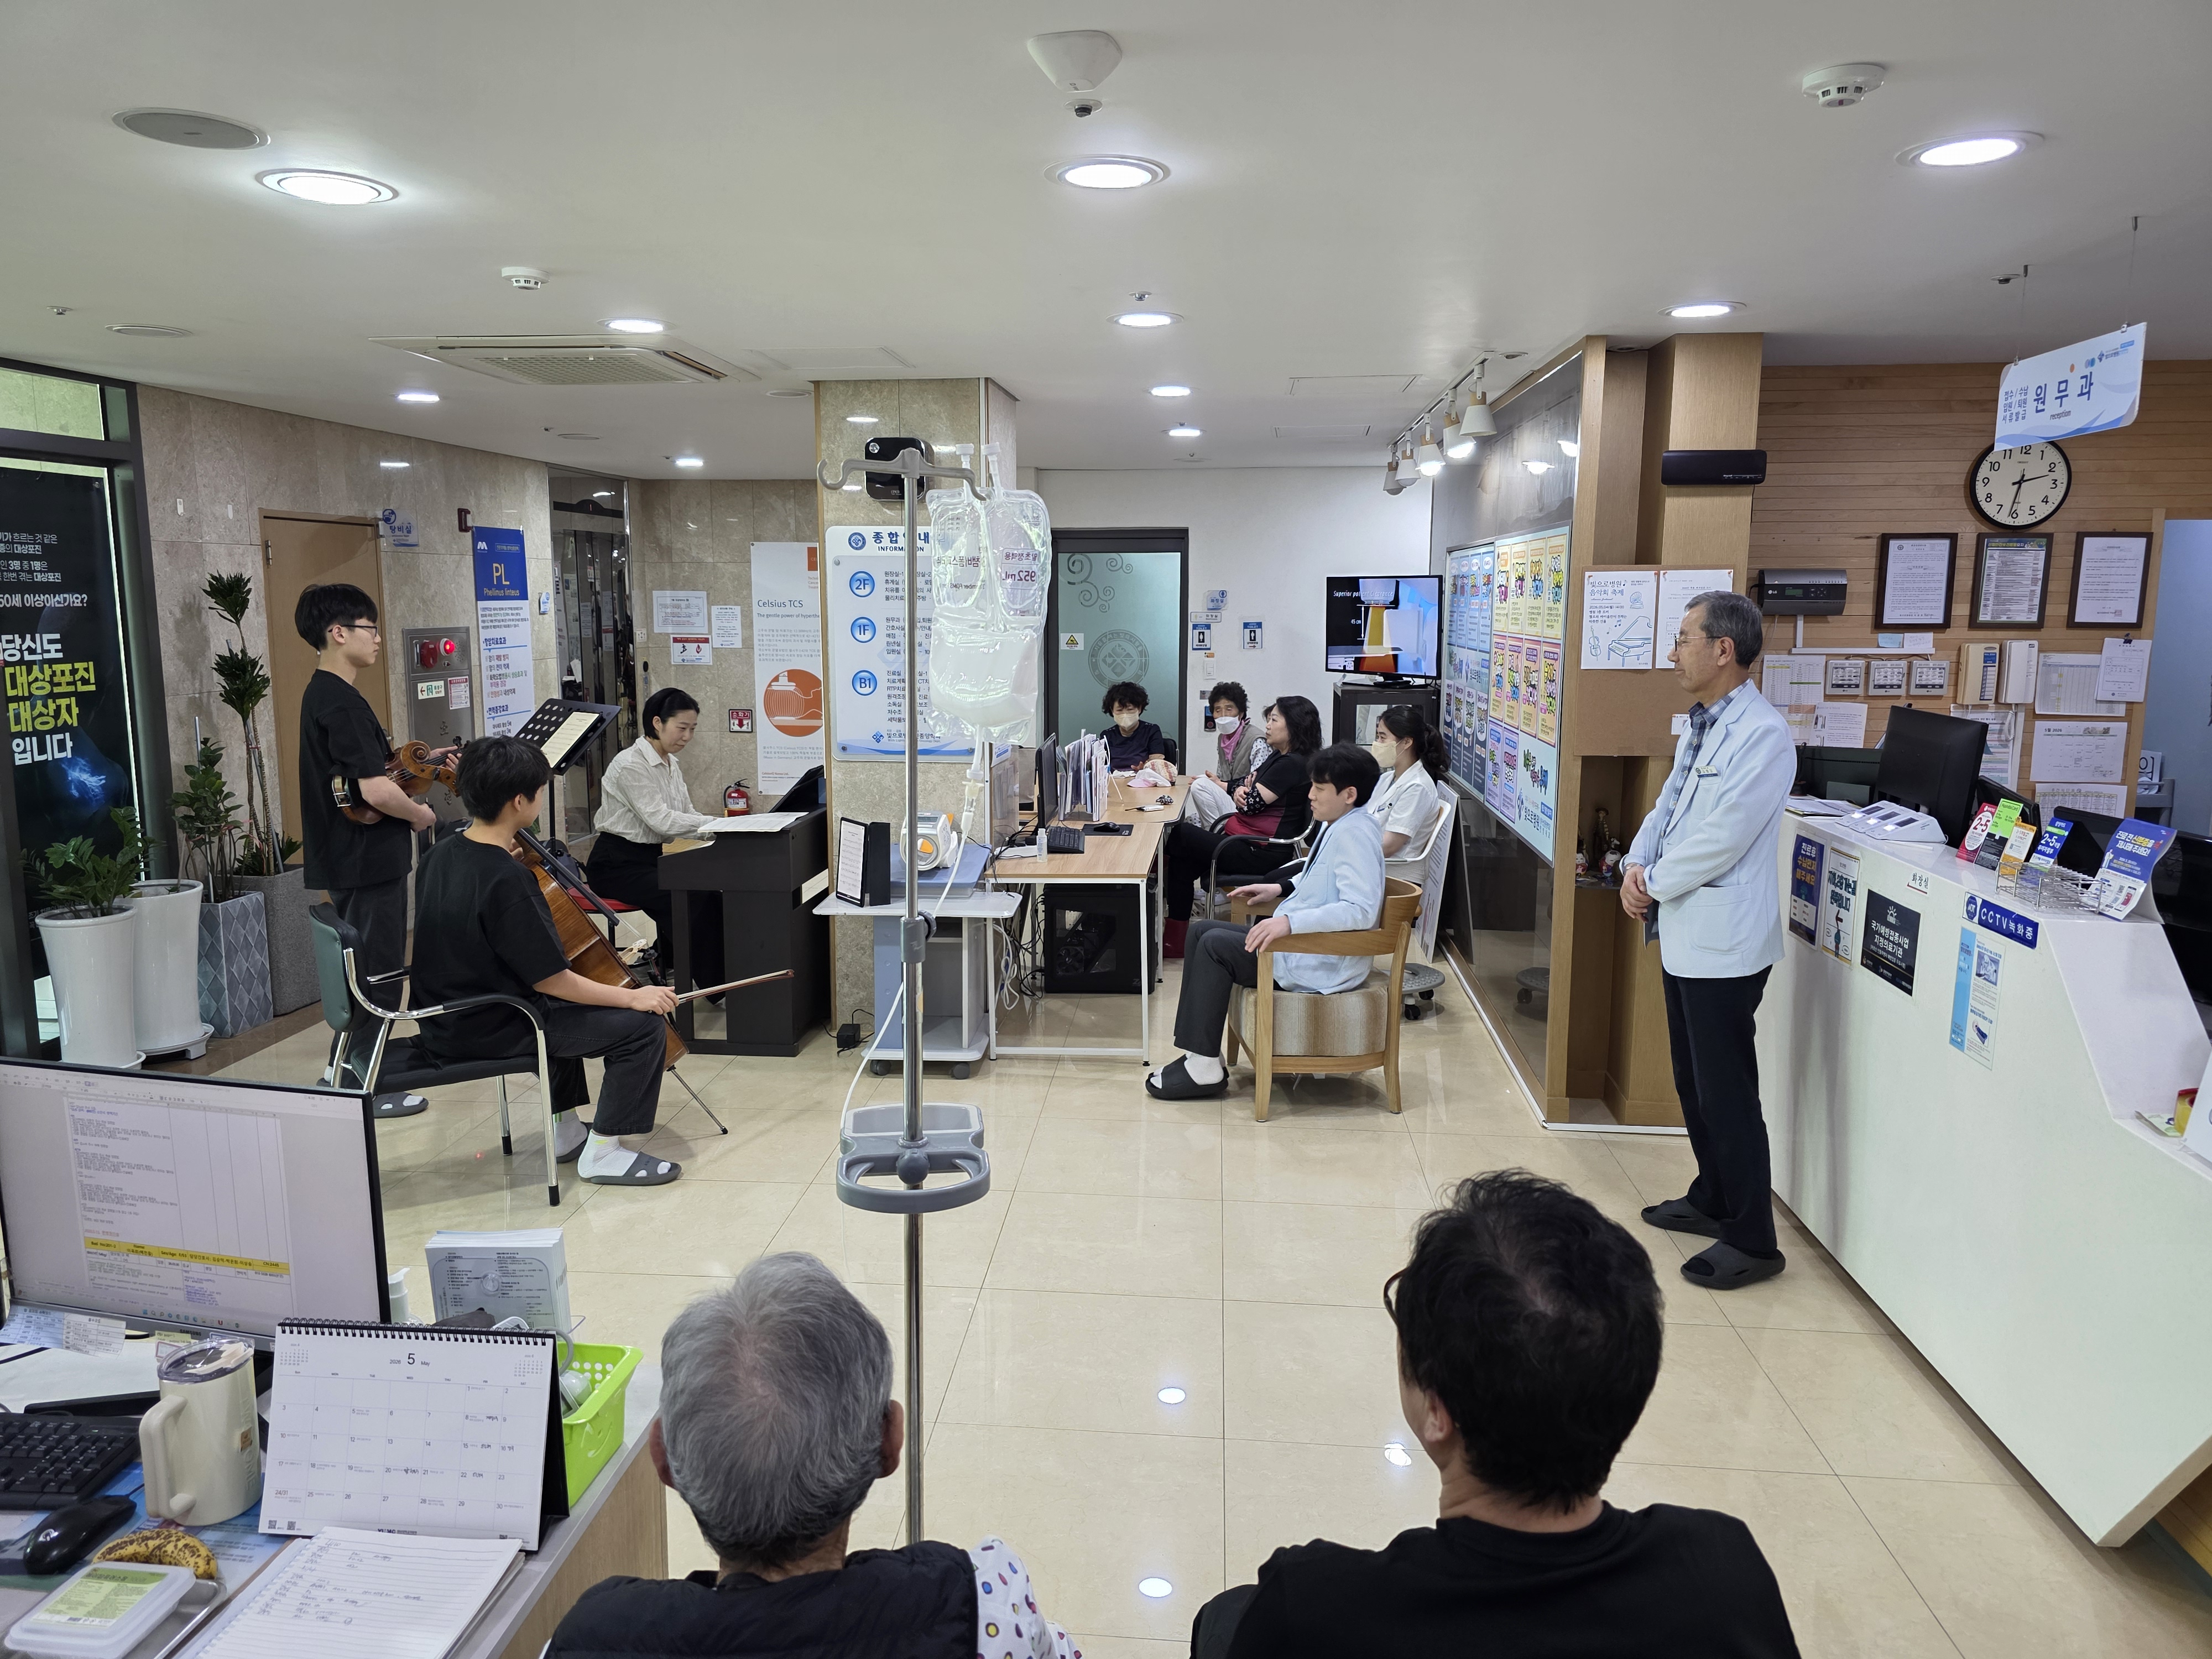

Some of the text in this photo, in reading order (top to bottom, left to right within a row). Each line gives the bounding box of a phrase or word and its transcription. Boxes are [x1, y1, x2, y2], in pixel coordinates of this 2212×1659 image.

[2033, 371, 2093, 414] 원무과
[2049, 409, 2071, 420] reception
[2003, 449, 2012, 460] 11
[2020, 445, 2032, 455] 12
[2040, 450, 2044, 460] 1
[1989, 461, 2000, 471] 10
[2048, 462, 2056, 472] 2
[1982, 477, 1990, 487] 9
[2050, 479, 2058, 489] 3
[1985, 493, 1992, 503] 8
[2041, 495, 2049, 505] 4
[1996, 504, 2003, 514] 7
[2011, 509, 2018, 519] 6
[2028, 505, 2036, 515] 5
[389, 525, 412, 534] 탕비실
[13, 533, 34, 543] 흐르는
[35, 534, 43, 543] 것
[43, 534, 58, 544] 같은
[872, 531, 930, 544] 종합내
[14, 544, 42, 554] 대상포진
[8, 560, 21, 570] 3명
[22, 561, 29, 571] 중
[30, 561, 48, 571] 1명은
[3, 572, 61, 582] 한번 겪는 대상포진
[493, 563, 510, 585] PL
[855, 579, 870, 590] 2F
[484, 588, 520, 596] Phellinus linteus
[0, 593, 87, 608] 50세 이상이신가요?
[757, 599, 804, 608] Celsius TCS
[857, 624, 870, 635] 1F
[2, 633, 64, 662] 당신도
[4, 661, 96, 697] 대상포진
[859, 677, 871, 688] B1
[8, 697, 79, 733] 대상자
[12, 732, 73, 766] 입니다
[1911, 873, 1929, 889] 화장실
[1871, 920, 1910, 950] 국가예방접종사업
[1874, 934, 1903, 958] 지정의료기관
[407, 1353, 415, 1365] 5
